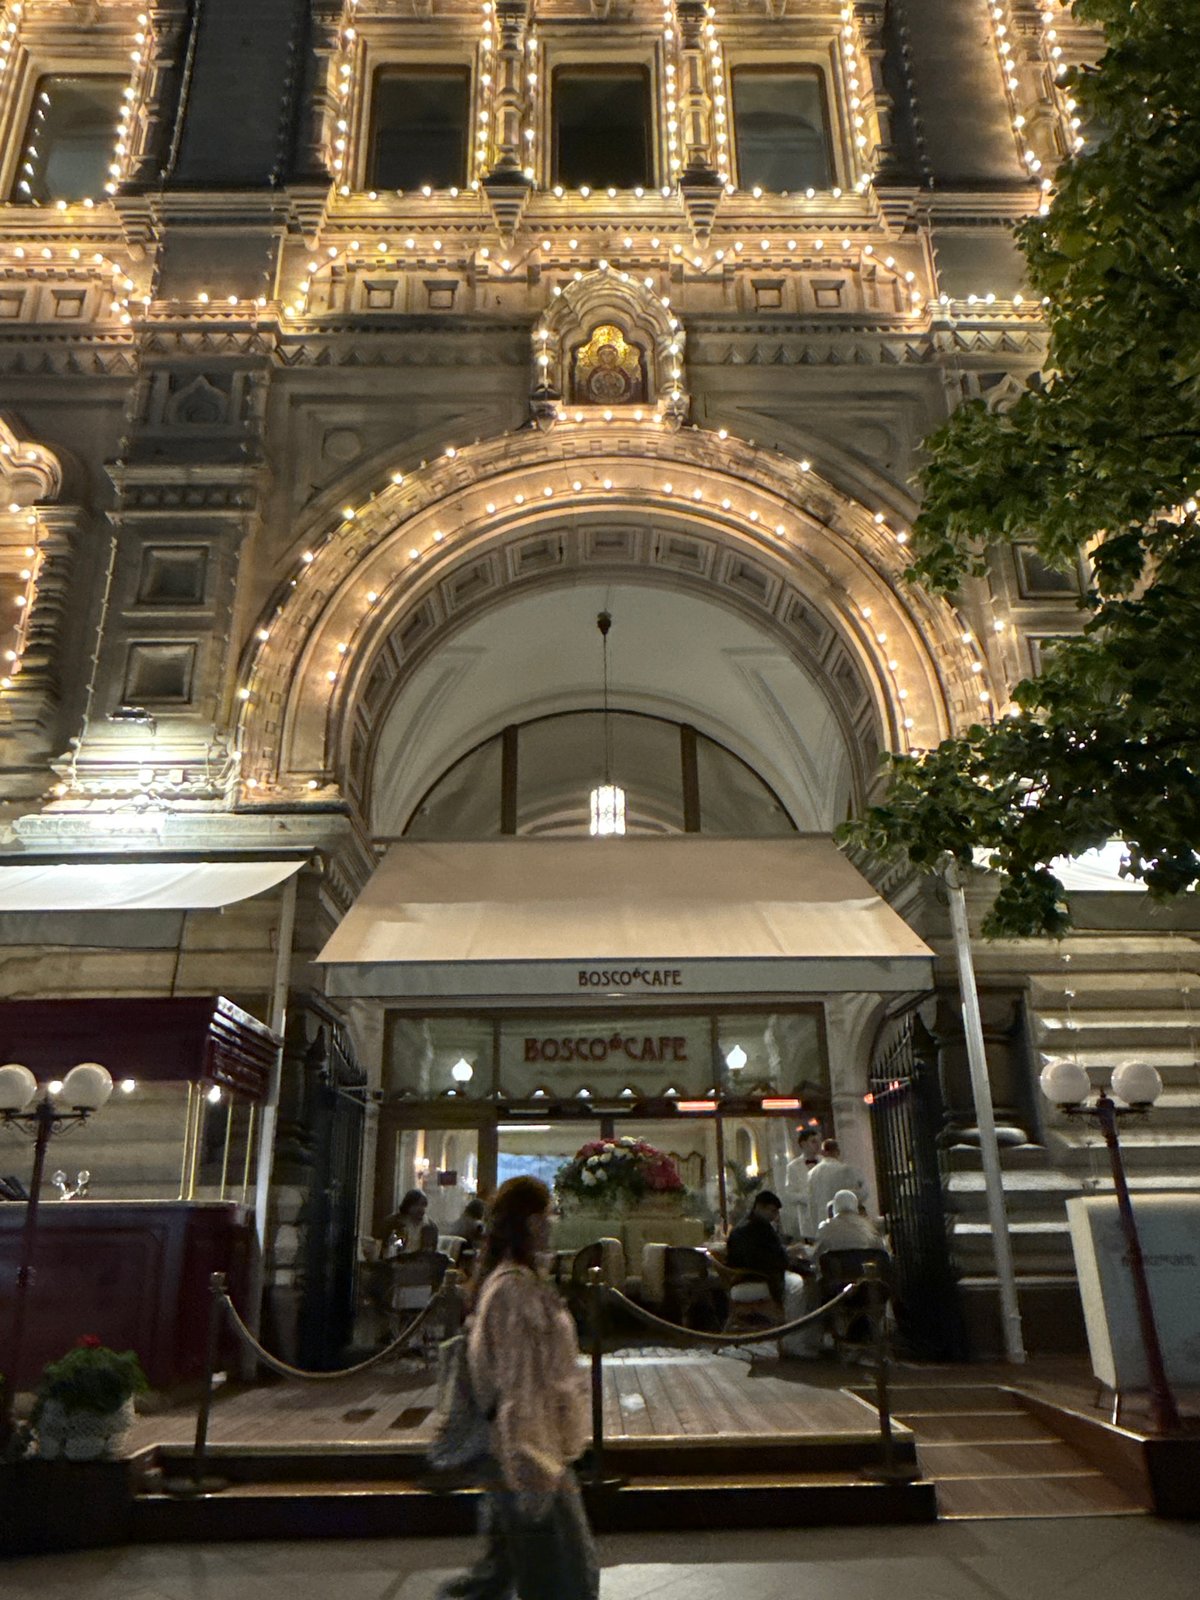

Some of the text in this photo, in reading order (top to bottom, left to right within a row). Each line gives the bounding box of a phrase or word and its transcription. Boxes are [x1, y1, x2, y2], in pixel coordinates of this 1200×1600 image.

[578, 969, 682, 986] BOSCO CAFE
[524, 1035, 688, 1063] BOSCO CAFE
